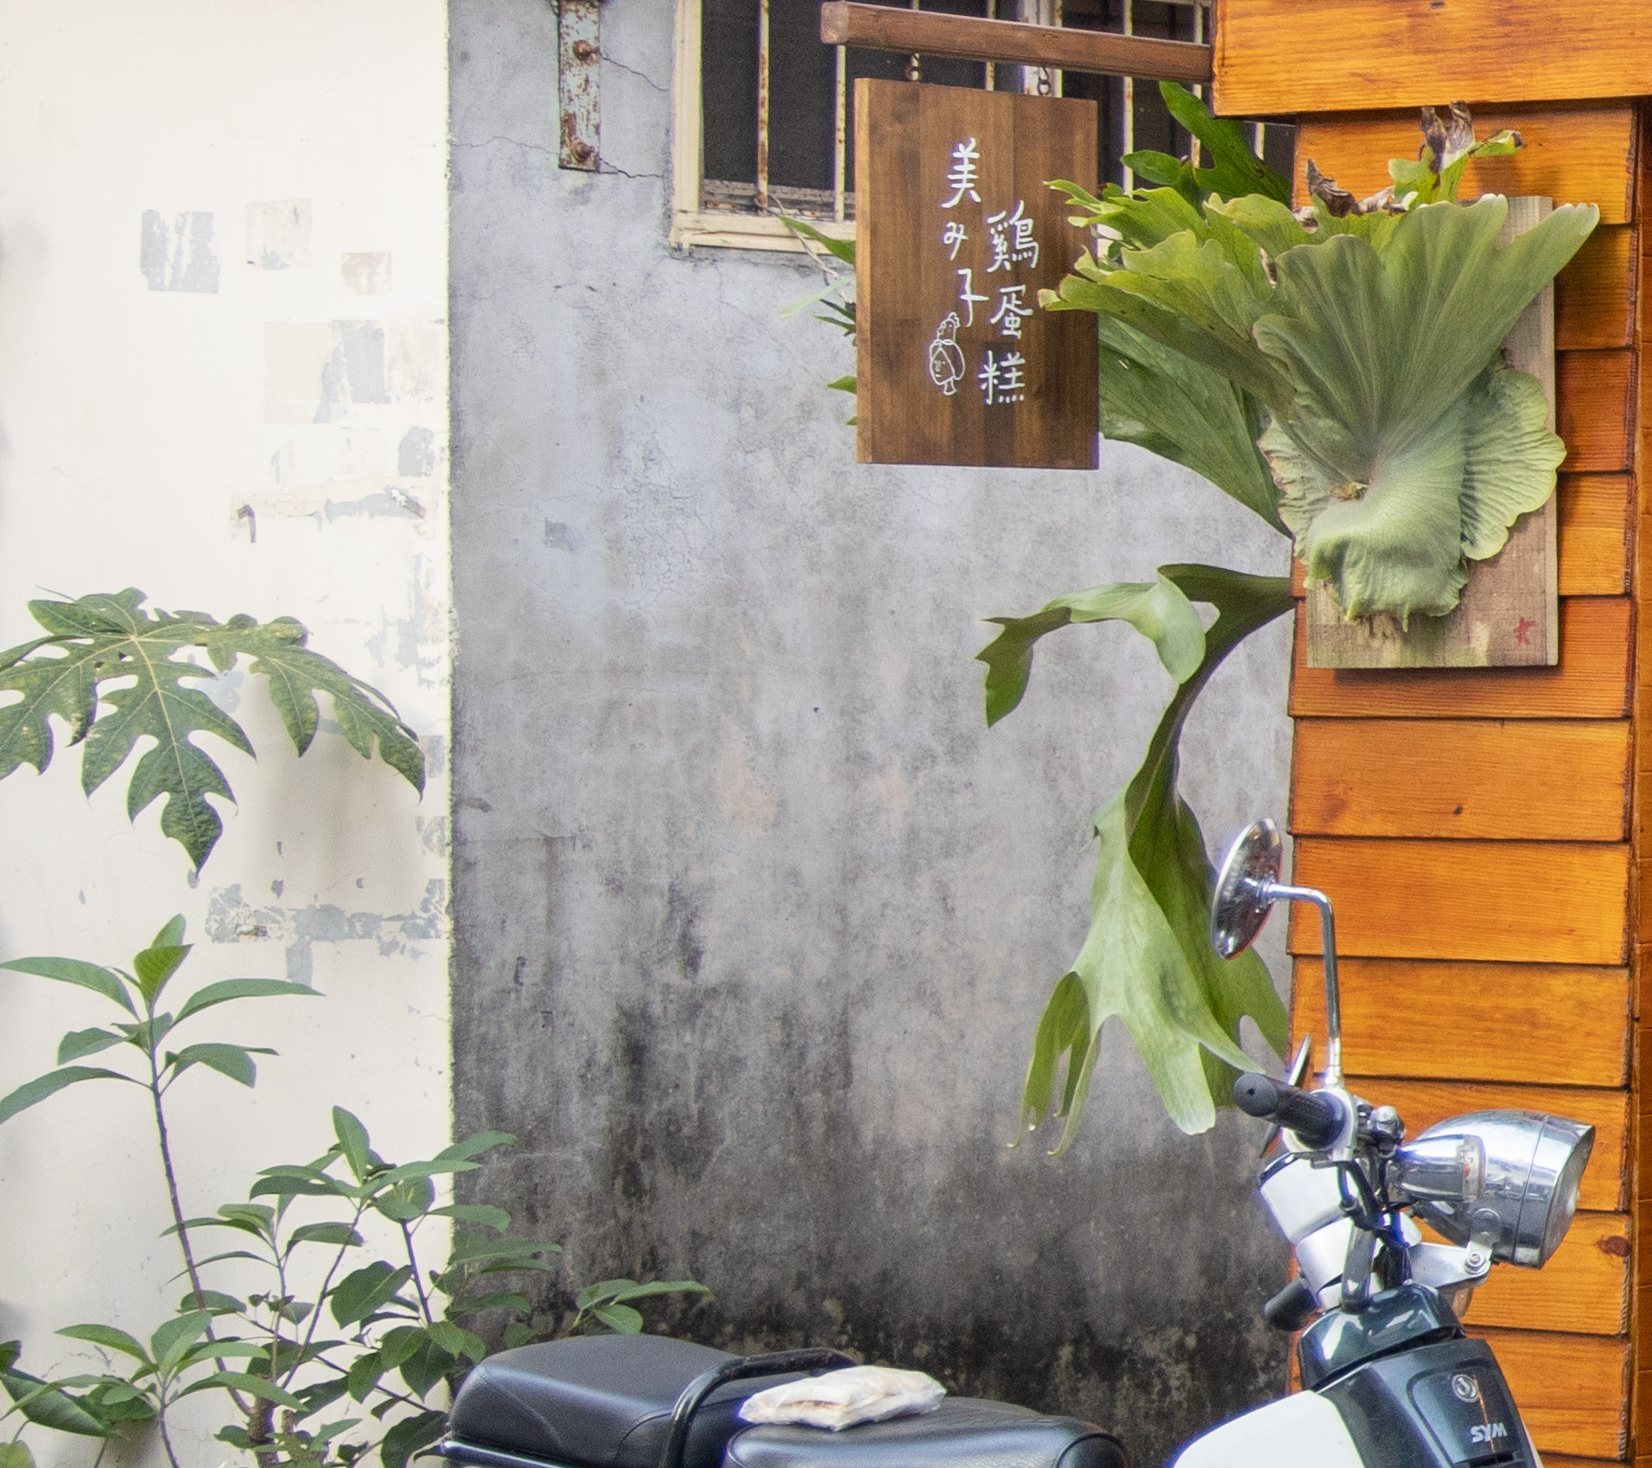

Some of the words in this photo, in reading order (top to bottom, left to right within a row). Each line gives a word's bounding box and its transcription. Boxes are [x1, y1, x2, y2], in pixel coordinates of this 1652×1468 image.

[941, 137, 989, 328] 美み子
[1470, 1422, 1508, 1443] SYM
